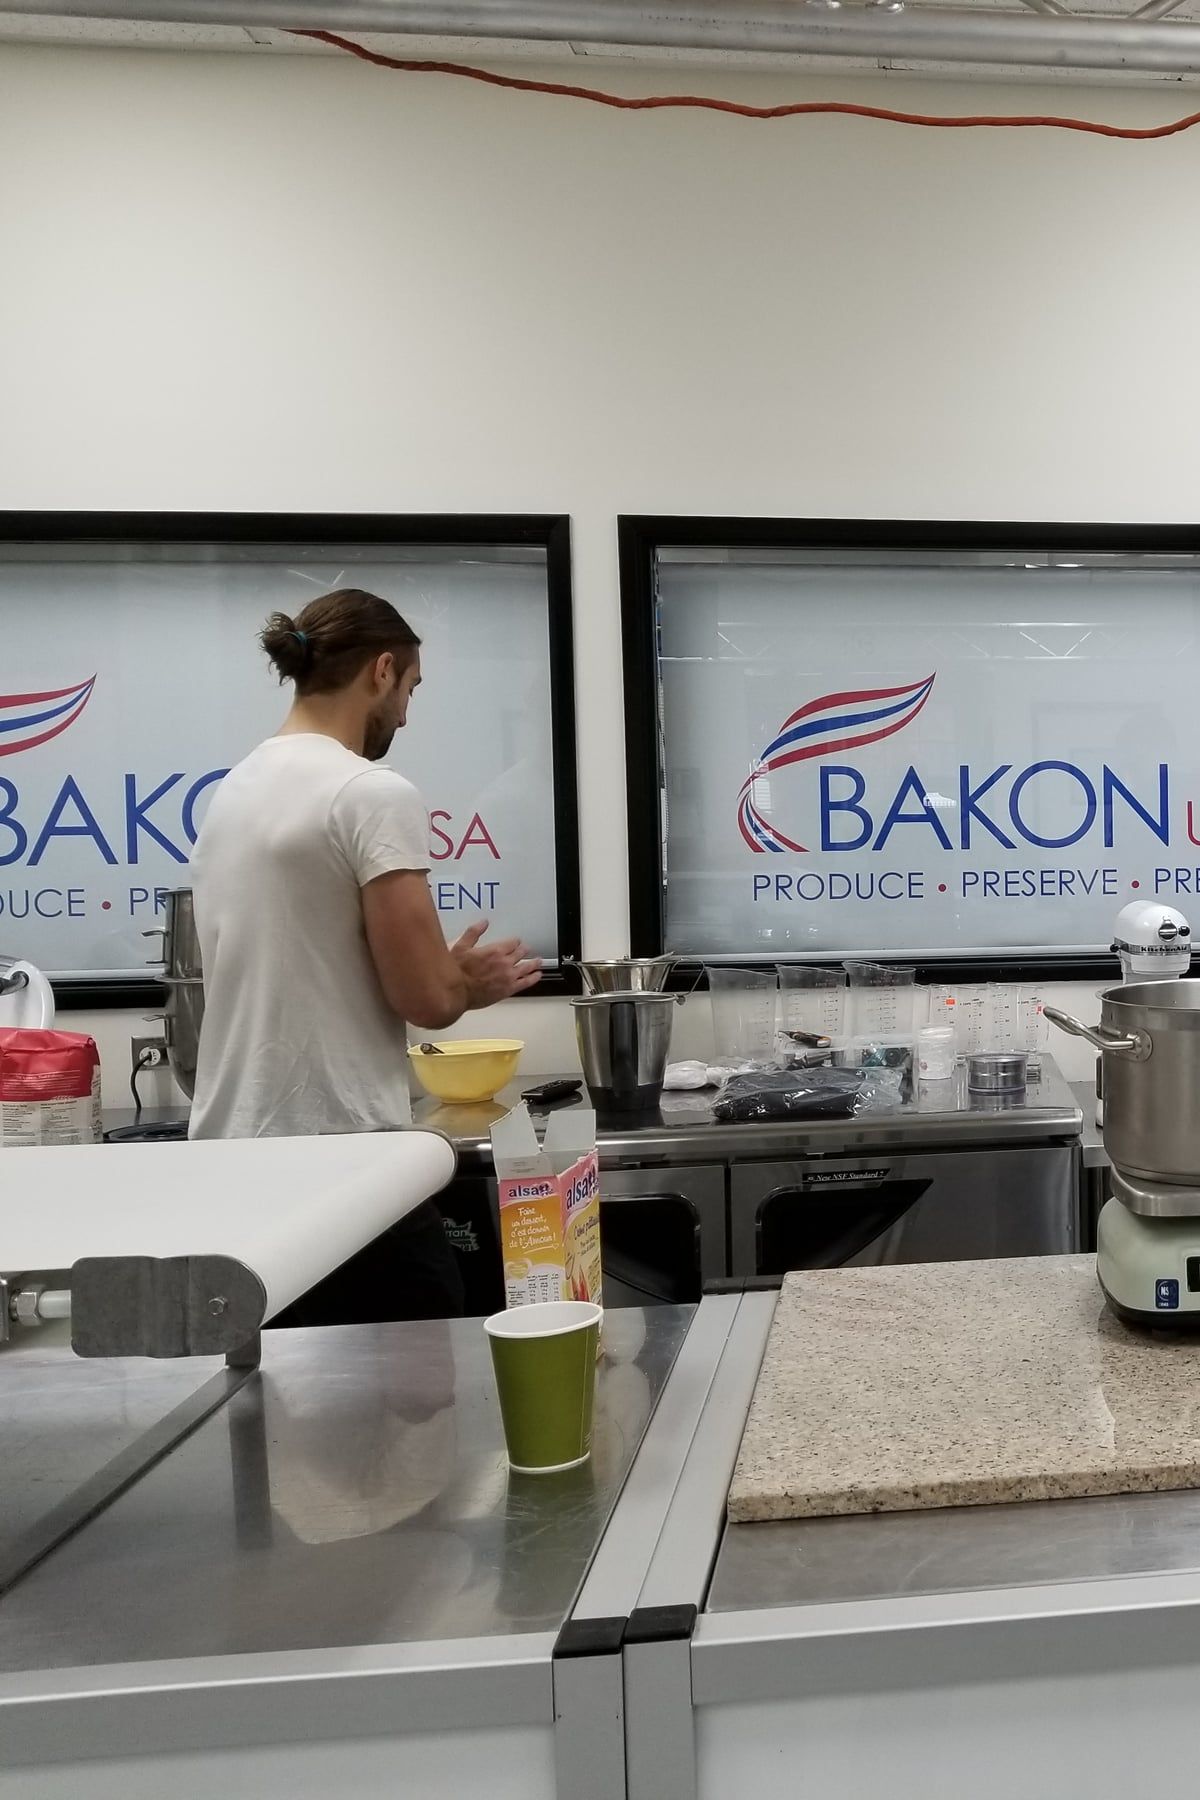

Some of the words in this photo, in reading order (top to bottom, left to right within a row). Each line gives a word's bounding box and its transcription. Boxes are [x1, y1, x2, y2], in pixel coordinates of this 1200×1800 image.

[819, 760, 1170, 852] BAKON
[429, 810, 501, 860] SA
[0, 888, 87, 919] UCE
[429, 882, 500, 910] ENT
[753, 871, 925, 902] PRODUCE
[962, 867, 1118, 898] PRESERVE
